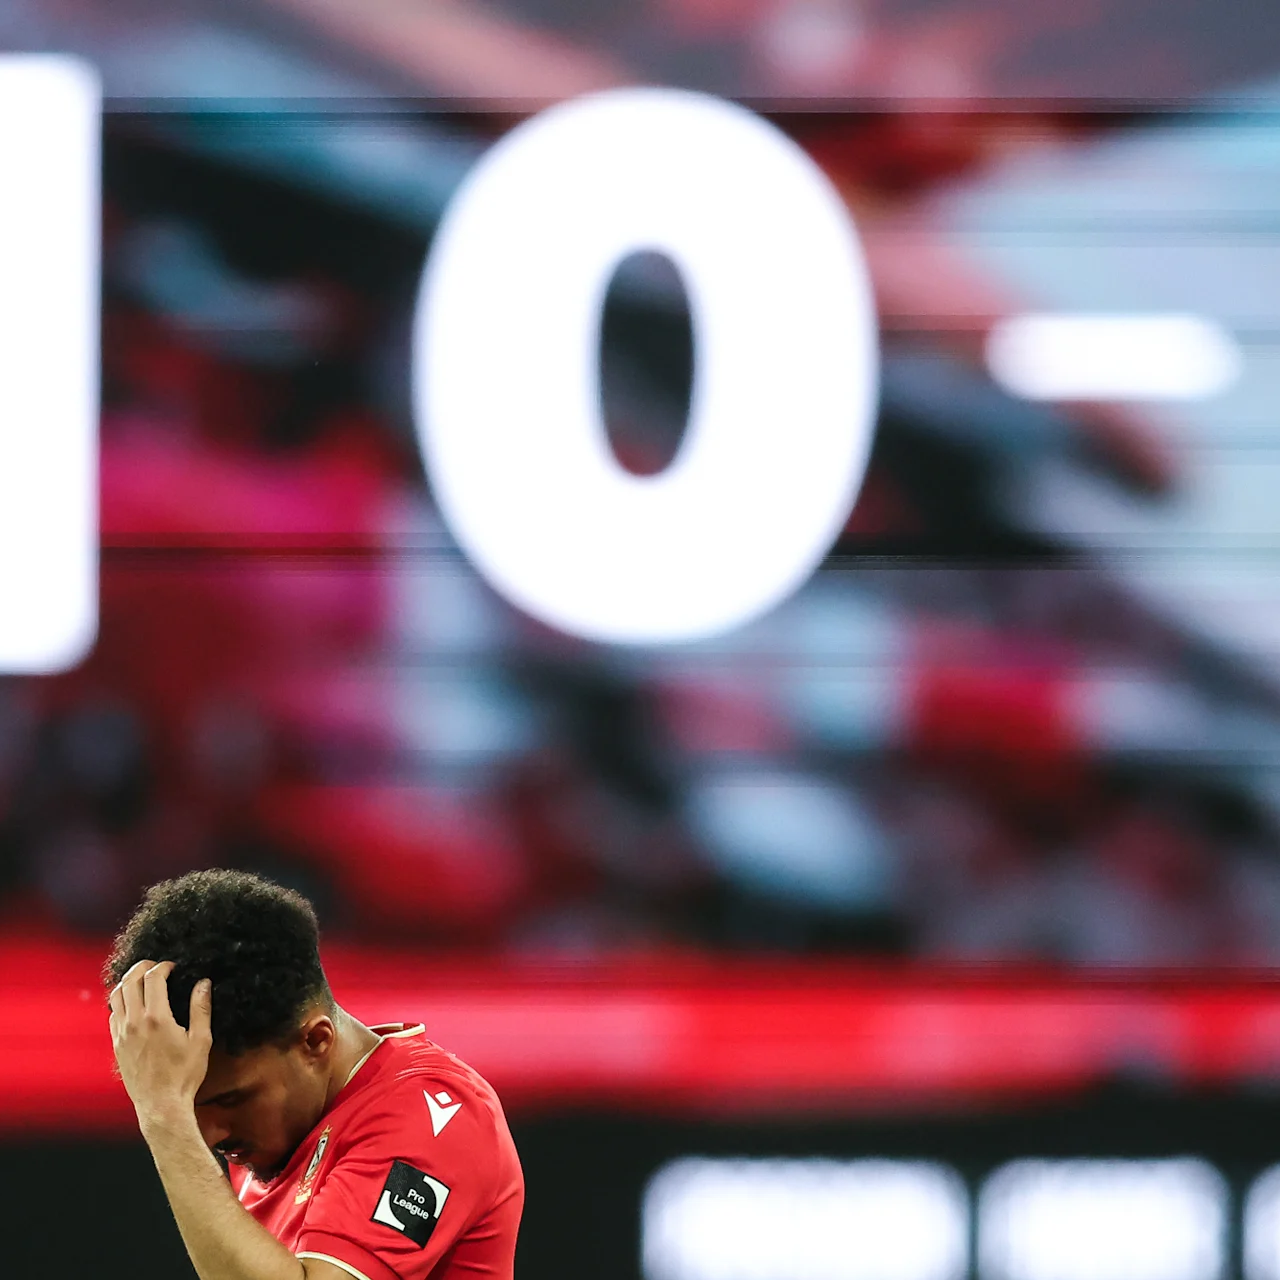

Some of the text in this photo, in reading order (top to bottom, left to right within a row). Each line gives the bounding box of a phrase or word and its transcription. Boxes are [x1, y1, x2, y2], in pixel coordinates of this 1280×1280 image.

[415, 89, 876, 643] 0
[393, 1194, 429, 1220] League
[407, 1188, 425, 1204] Pro
